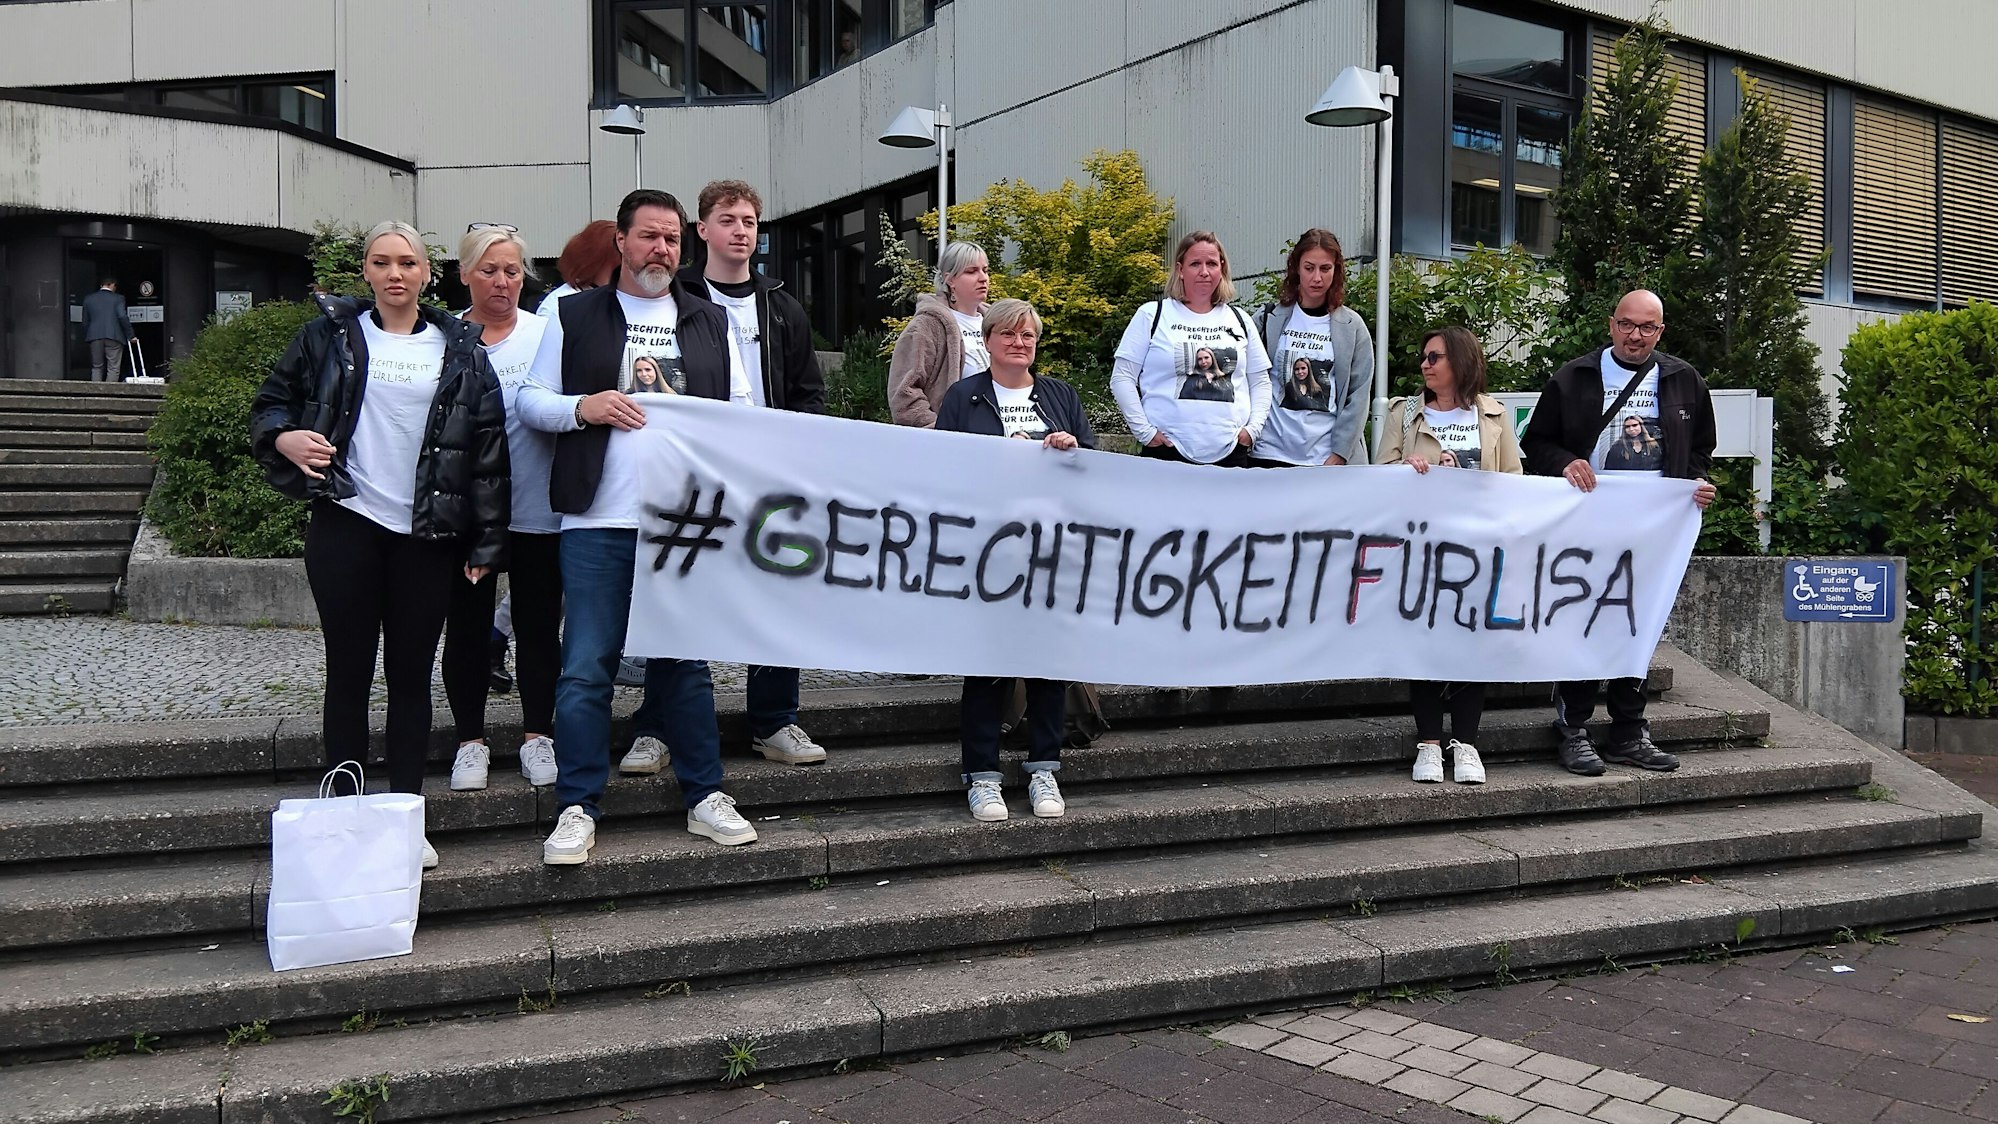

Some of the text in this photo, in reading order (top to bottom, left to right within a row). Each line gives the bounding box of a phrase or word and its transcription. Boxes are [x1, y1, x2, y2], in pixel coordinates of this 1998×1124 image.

[1188, 333, 1202, 341] FÜR
[650, 338, 672, 347] LISA
[1291, 340, 1324, 351] FÜR LISA
[496, 362, 528, 377] GKEIT
[1637, 400, 1655, 408] LISA
[1020, 415, 1039, 423] LISA
[1449, 434, 1467, 442] LISA
[645, 484, 1637, 639] #GERECHTIGKEITFÜRLISA
[1813, 565, 1859, 576] Eingang
[1820, 585, 1851, 593] anderen
[1825, 594, 1845, 602] Seite
[1798, 603, 1872, 613] des Mühlengrabens
